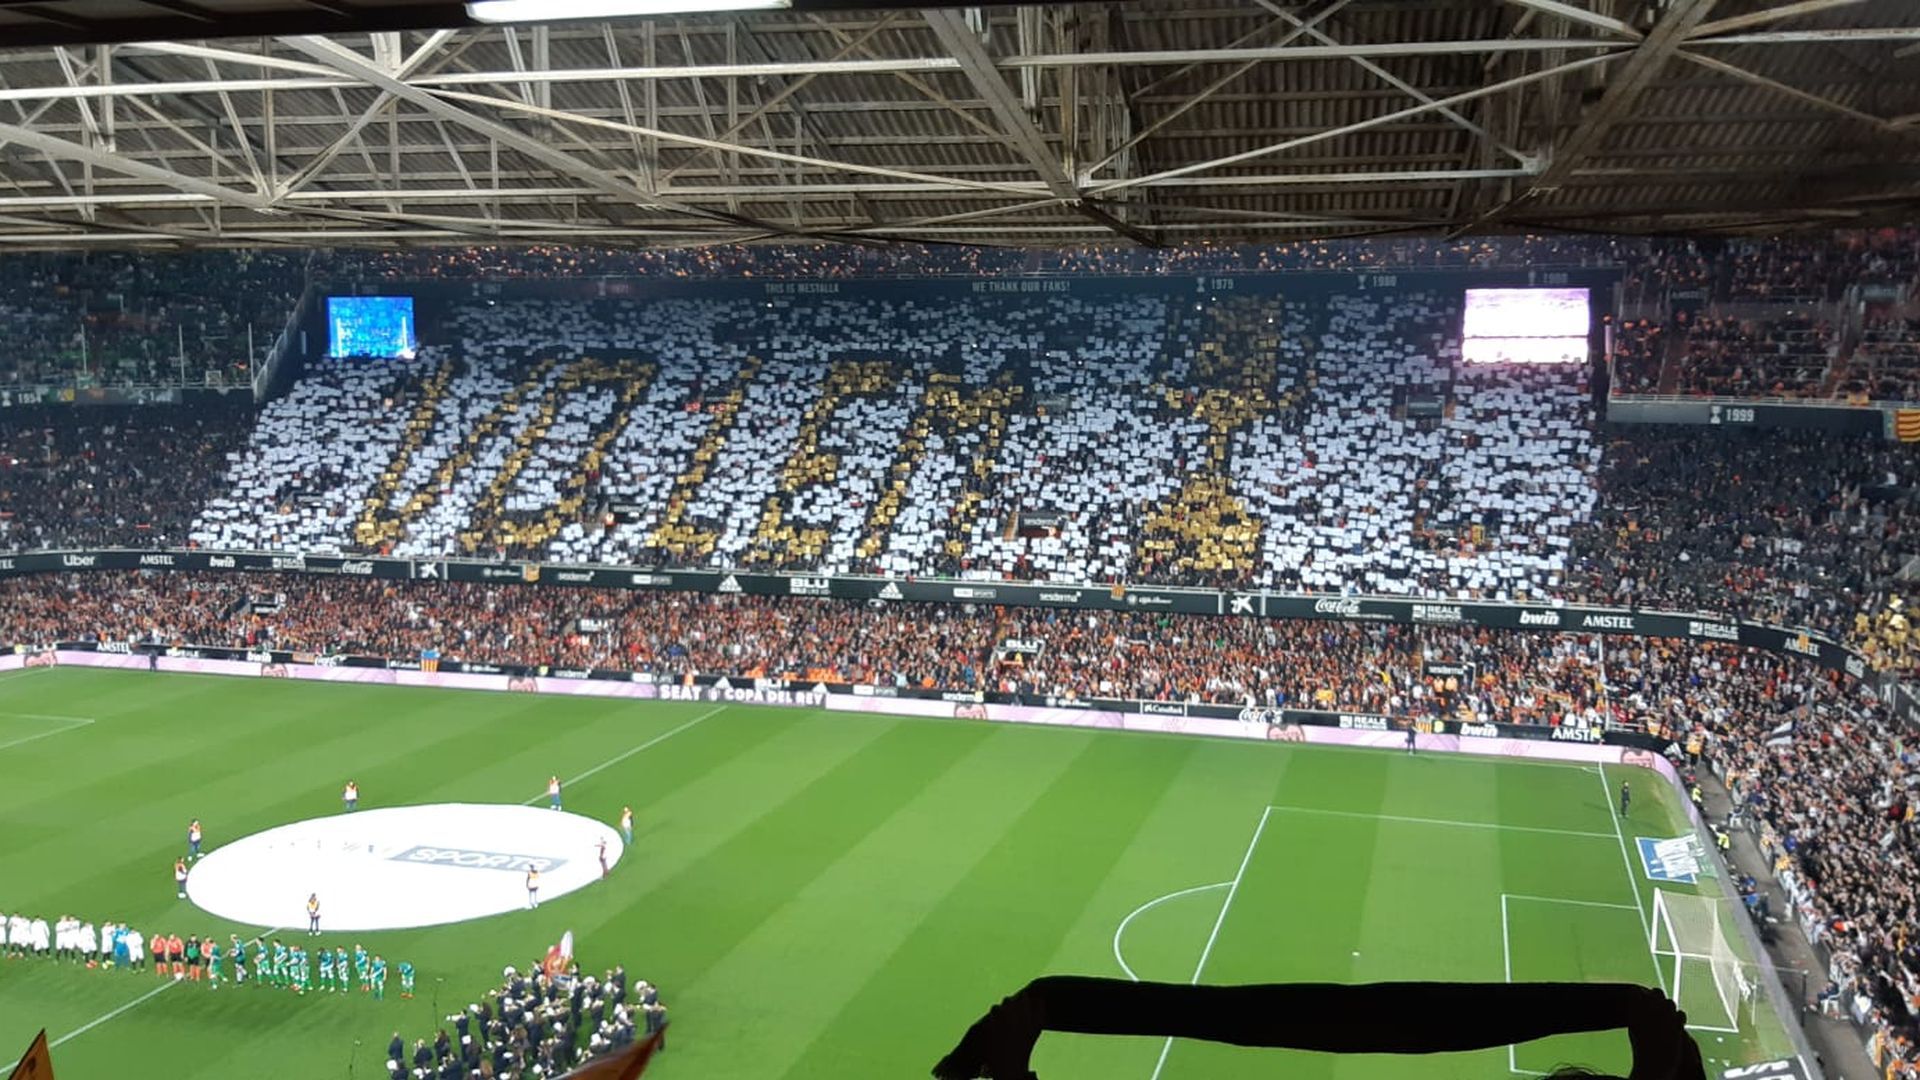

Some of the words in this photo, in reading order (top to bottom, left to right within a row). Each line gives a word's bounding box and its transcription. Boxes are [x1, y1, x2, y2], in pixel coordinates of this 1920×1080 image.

[797, 283, 839, 293] MESTALLA
[972, 281, 987, 293] WE
[989, 281, 1018, 293] THANK
[1020, 281, 1039, 293] OUR
[1042, 281, 1070, 293] FANS!
[1725, 408, 1755, 422] 1999
[63, 555, 96, 566] Uber
[139, 555, 175, 565] AMSTEL
[209, 556, 236, 568] bwin
[1519, 610, 1560, 625] bwin
[1583, 615, 1634, 629] AMSTEL
[659, 685, 702, 700] SEAT
[725, 687, 764, 702] COPA
[767, 689, 793, 703] DEL
[798, 691, 823, 706] REY
[1460, 723, 1498, 738] bwin
[410, 848, 553, 873] SPORTS
